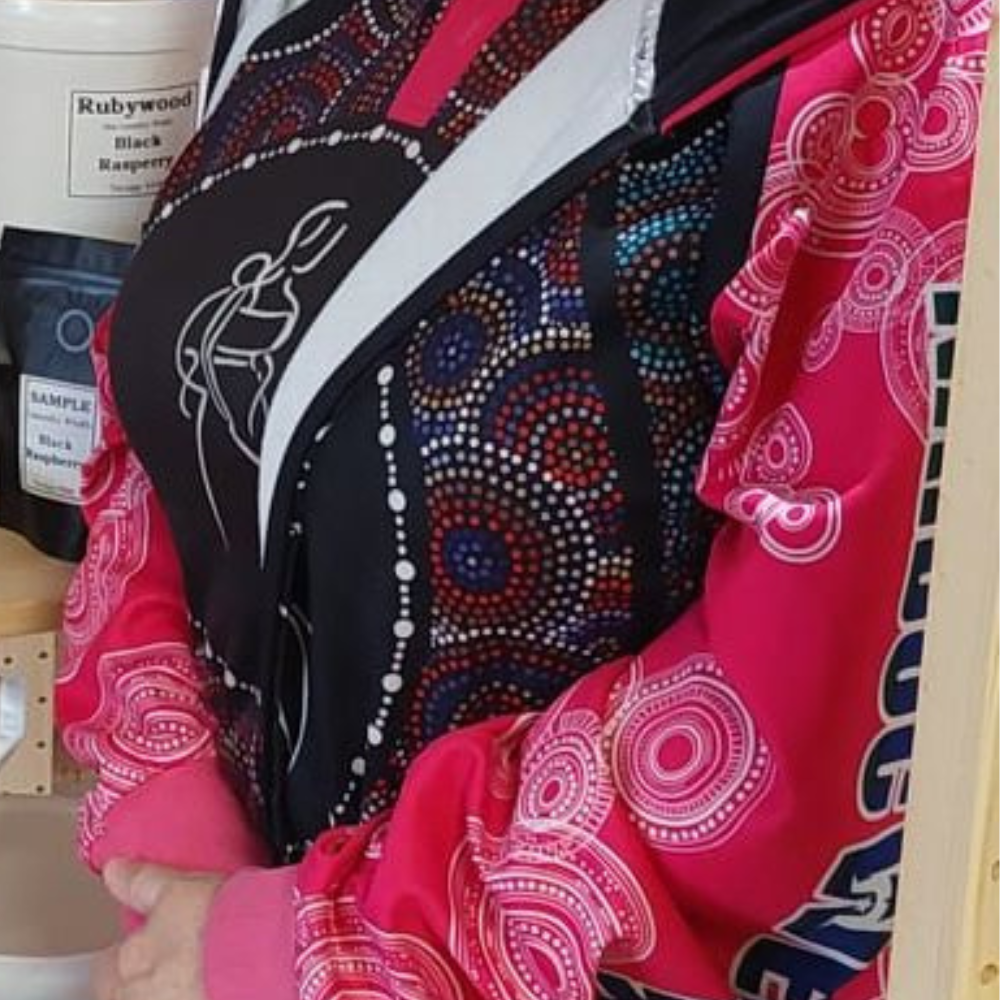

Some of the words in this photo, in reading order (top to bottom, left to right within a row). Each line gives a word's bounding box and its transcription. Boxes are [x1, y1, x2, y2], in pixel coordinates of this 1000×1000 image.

[78, 89, 193, 119] Rubywood
[114, 135, 162, 150] Black
[31, 390, 92, 414] SAMPLE
[39, 433, 72, 451] Black
